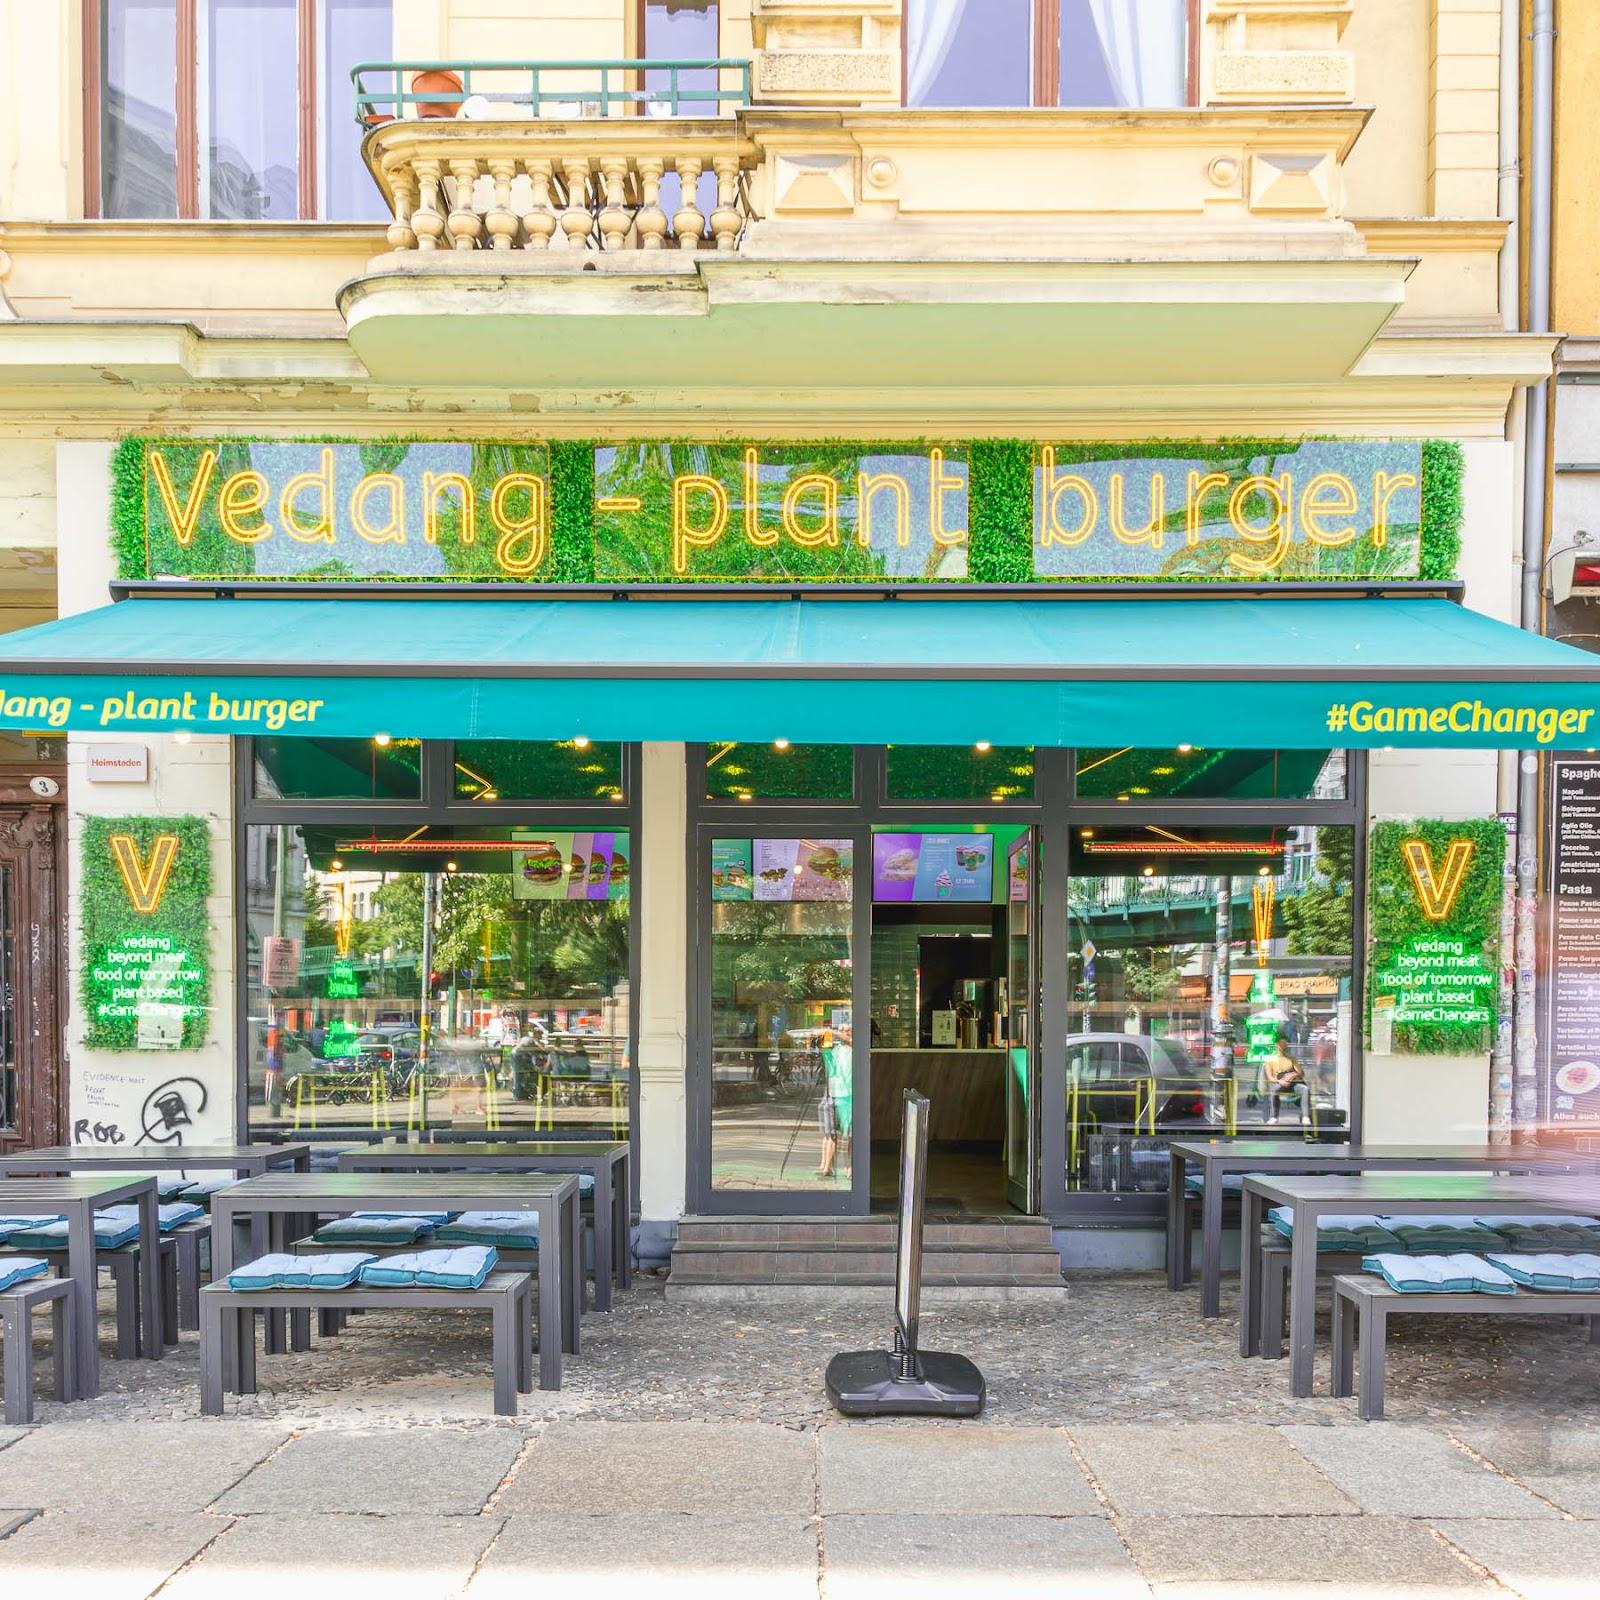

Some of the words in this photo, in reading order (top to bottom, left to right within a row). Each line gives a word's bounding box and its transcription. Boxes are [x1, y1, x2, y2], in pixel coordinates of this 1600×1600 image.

[150, 447, 546, 574] Vedang
[673, 447, 966, 573] plant
[1039, 445, 1416, 573] burger
[101, 691, 197, 726] plant
[208, 692, 324, 730] burger
[1326, 700, 1595, 744] #GameChanger
[39, 780, 49, 794] 3
[110, 834, 178, 912] V
[1404, 841, 1473, 918] V
[1560, 884, 1592, 894] Pasta
[123, 935, 171, 951] vedang
[1413, 940, 1463, 955] vedang
[108, 949, 153, 966] beyond
[1398, 953, 1445, 970] beyond
[1447, 955, 1480, 968] meat
[94, 966, 123, 981] food
[124, 967, 139, 981] of
[140, 969, 201, 981] tomorrow
[1383, 971, 1413, 986] food
[1414, 972, 1428, 986] of
[1430, 973, 1492, 986] tomorrow
[113, 985, 144, 1002] plant
[146, 985, 184, 999] based
[1402, 989, 1434, 1006] plant
[1436, 989, 1474, 1003] based
